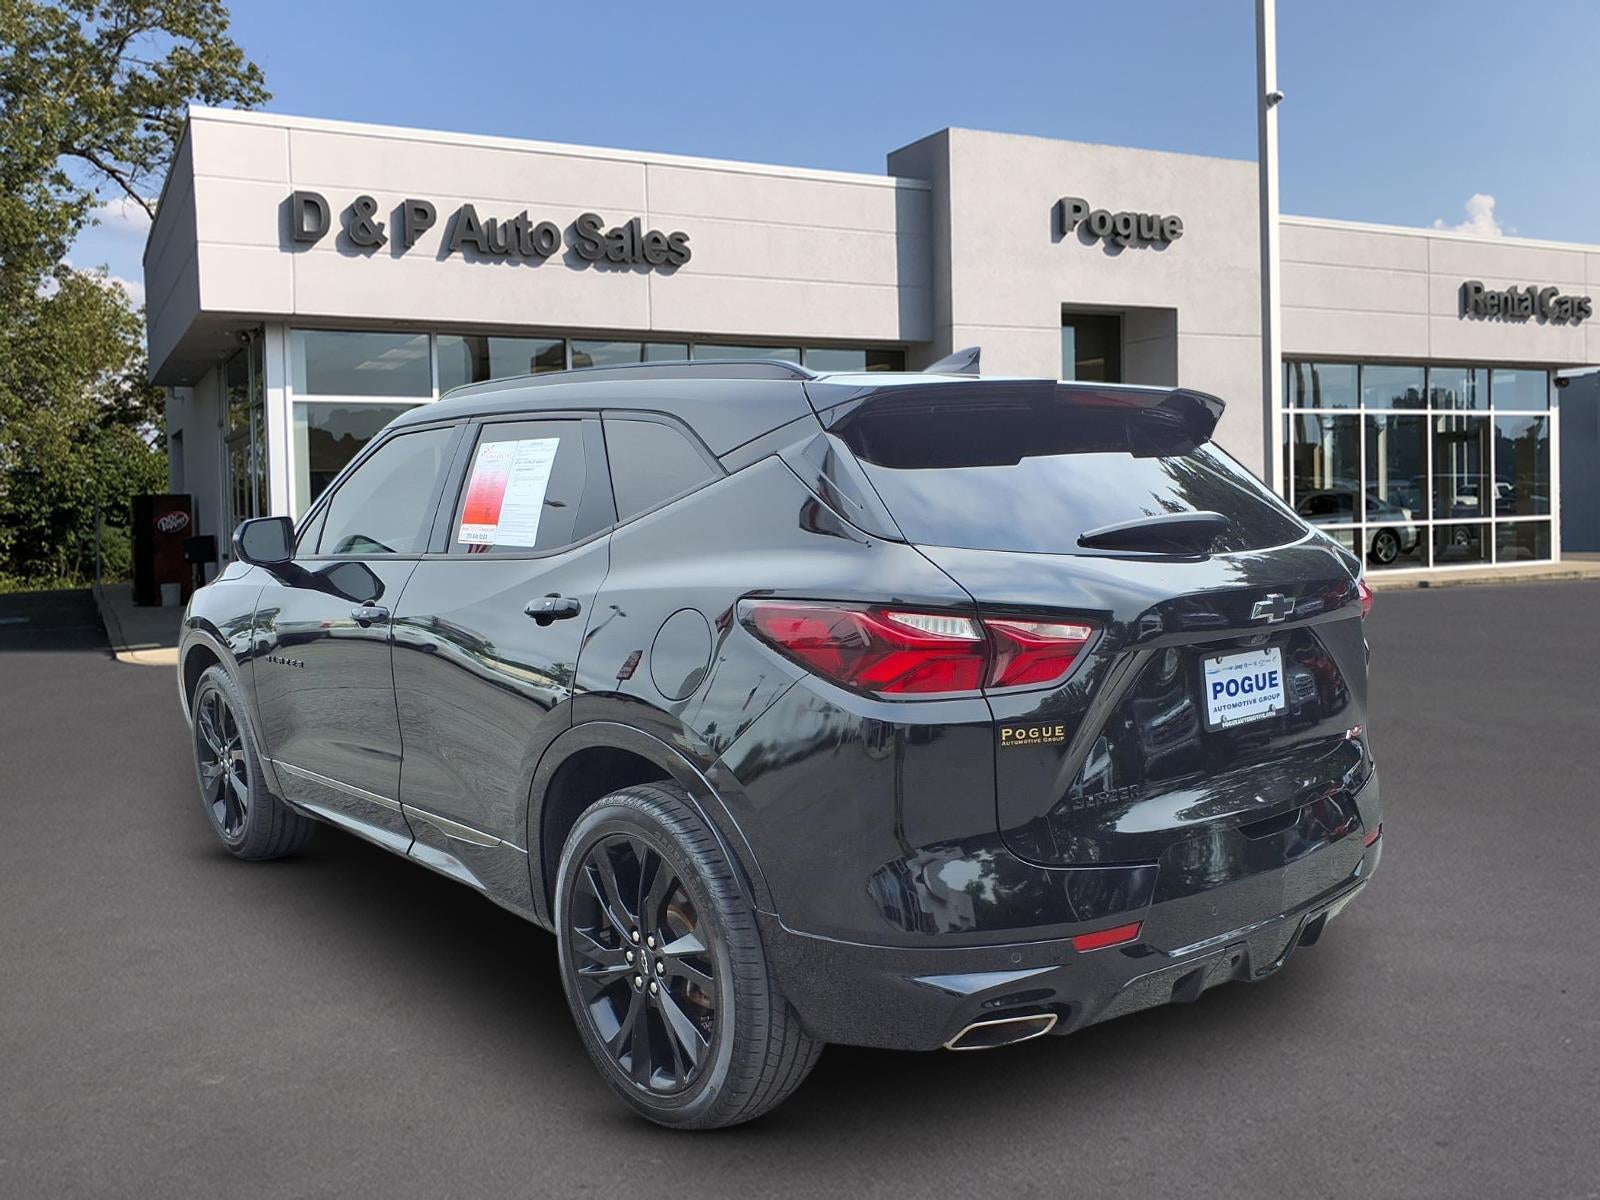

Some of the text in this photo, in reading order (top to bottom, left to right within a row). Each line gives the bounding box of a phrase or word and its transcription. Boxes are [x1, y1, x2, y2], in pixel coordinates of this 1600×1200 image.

[290, 190, 692, 267] D & P Auto Sales
[1056, 196, 1184, 249] Pogue
[1462, 280, 1593, 322] Rental Cars
[1212, 669, 1279, 701] POGUE
[1213, 692, 1281, 713] AUTOMOTIVE GROUP
[1001, 725, 1065, 741] POGUE
